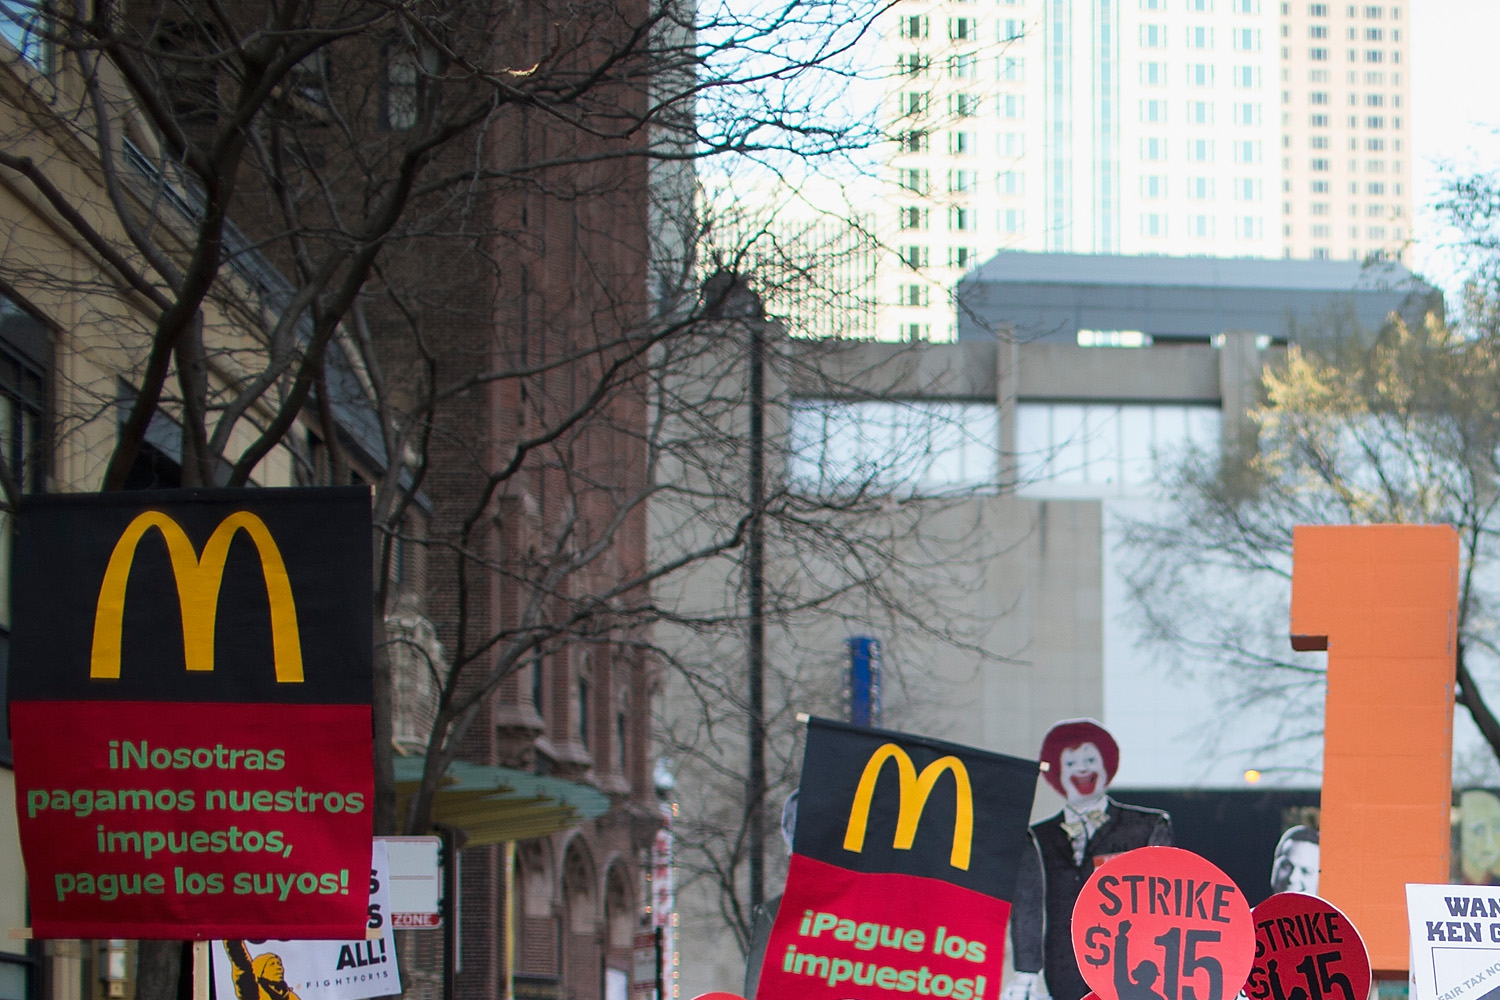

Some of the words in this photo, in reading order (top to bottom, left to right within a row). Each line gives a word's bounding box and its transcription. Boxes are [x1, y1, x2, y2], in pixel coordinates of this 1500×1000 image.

[27, 788, 195, 818] pagamos
[205, 788, 365, 813] nuestros
[97, 825, 293, 859] impuestos,
[55, 871, 165, 901] pague
[175, 867, 224, 895] los
[233, 870, 350, 901] suyos!
[1096, 875, 1235, 924] STRIKE
[393, 913, 434, 926] ZONE
[1254, 912, 1343, 958] STRIKE
[1426, 921, 1482, 943] KEN
[336, 940, 387, 970] ALL!
[934, 926, 986, 963] los
[1462, 971, 1488, 992] TAX
